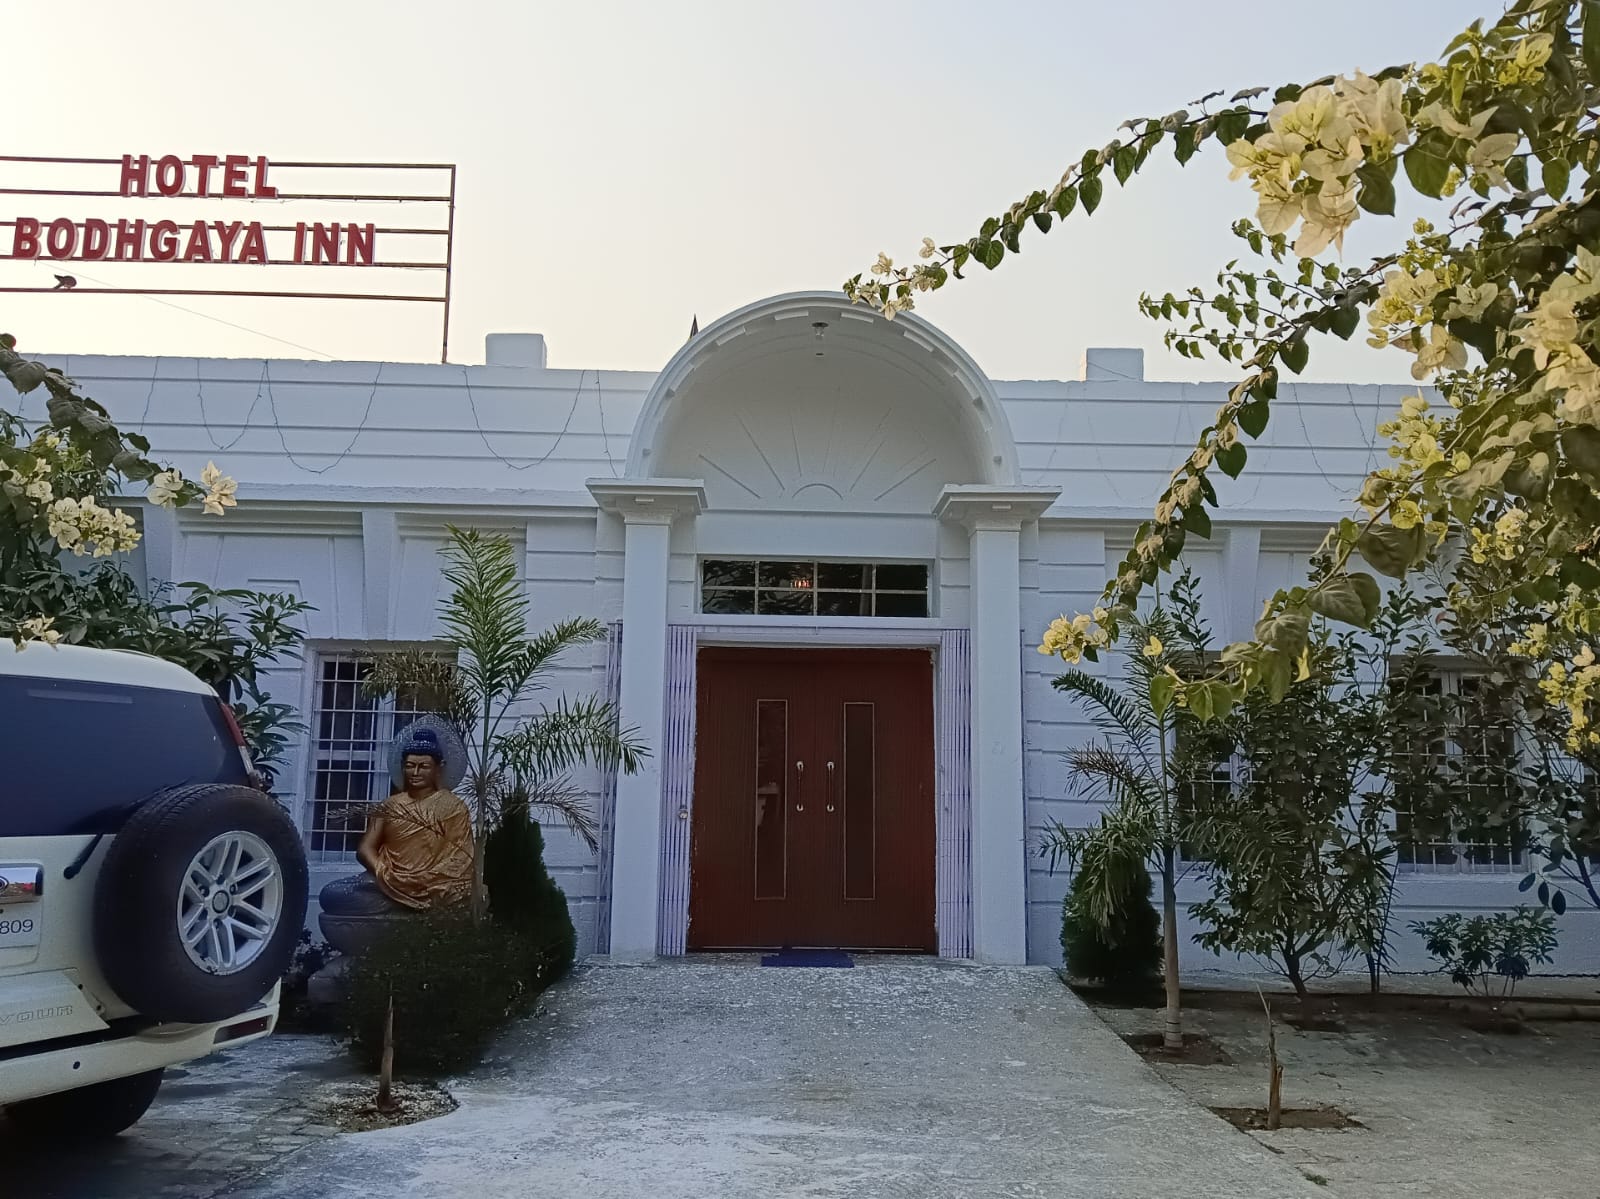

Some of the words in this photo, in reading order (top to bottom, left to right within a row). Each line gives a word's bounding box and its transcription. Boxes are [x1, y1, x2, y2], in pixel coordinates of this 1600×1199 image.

[119, 154, 278, 199] HOTEL
[12, 217, 269, 264] BODHGAYA
[293, 222, 376, 265] INN
[0, 919, 33, 934] 809
